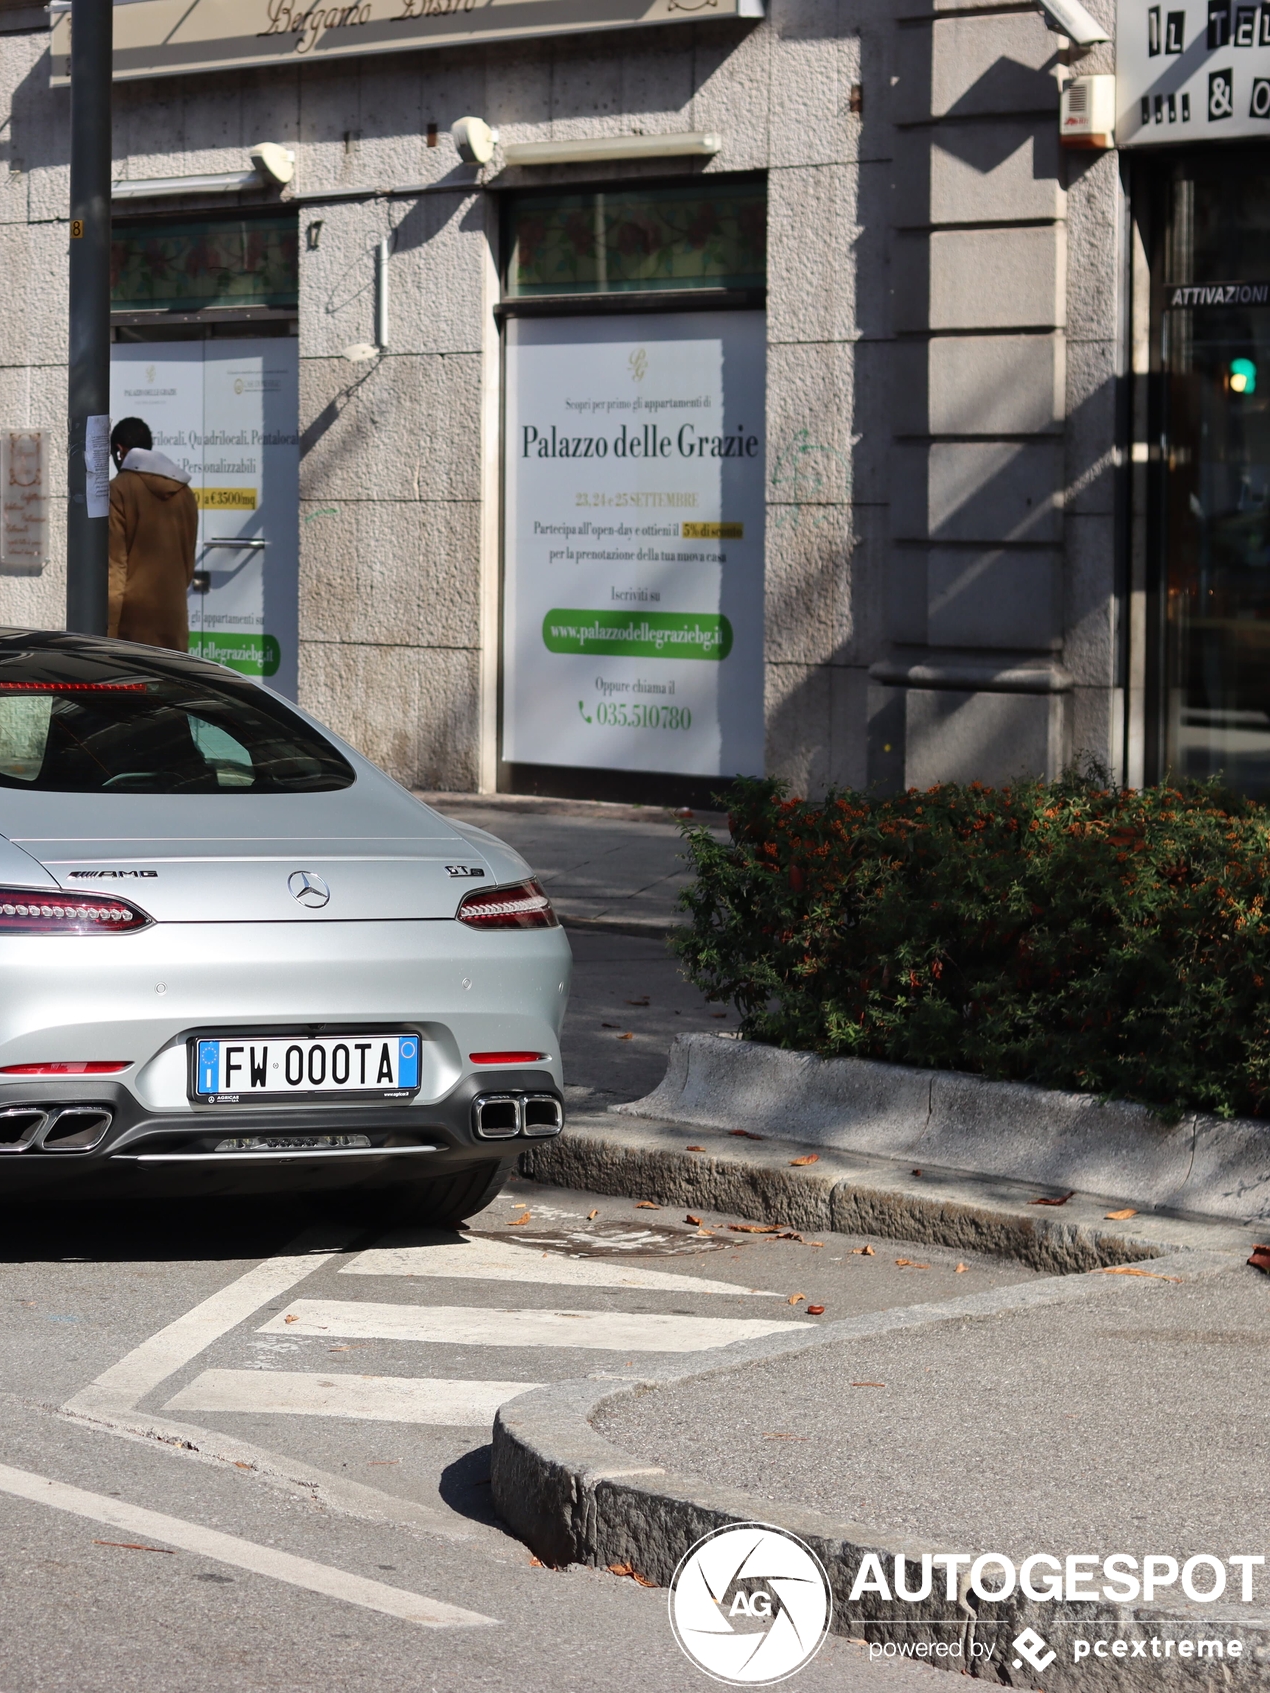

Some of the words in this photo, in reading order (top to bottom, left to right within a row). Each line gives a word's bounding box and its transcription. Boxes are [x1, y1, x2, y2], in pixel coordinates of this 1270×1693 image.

[256, 0, 372, 53] Bergamo
[1208, 5, 1270, 48] TEL
[1249, 79, 1270, 117] O
[1171, 286, 1269, 305] ATTIVAZIONI
[565, 398, 590, 413] Scopri
[592, 401, 606, 413] per
[607, 399, 631, 413] primo
[633, 398, 643, 413] gli
[644, 397, 702, 413] appartamenti
[703, 396, 711, 408] di
[152, 430, 187, 447] rilocali,
[251, 429, 299, 446] Pentalocal
[522, 425, 608, 458] Palazzo
[614, 424, 671, 458] delle
[677, 423, 759, 458] Grazie
[593, 493, 606, 507] 24
[608, 496, 614, 507] e
[615, 492, 628, 507] 25
[630, 492, 699, 508] SETTEMBRE
[534, 521, 577, 539] Partecipa
[635, 526, 641, 536] e
[642, 523, 671, 537] ottieni
[673, 522, 679, 536] il
[683, 524, 700, 537] 5%
[700, 524, 710, 537] di
[549, 549, 565, 563] per
[566, 547, 575, 560] la
[576, 548, 635, 563] prenotazione
[636, 548, 660, 562] della
[661, 551, 676, 562] tua
[677, 552, 705, 563] nuova
[706, 553, 727, 563] casa
[611, 586, 649, 602] Iscriviti
[650, 592, 661, 602] su
[550, 621, 723, 652] www.palazzodellegraziebg.it
[188, 641, 274, 668] odellegraziebg.it
[595, 676, 631, 696] Oppure
[632, 679, 667, 694] chiama
[668, 680, 675, 695] il
[597, 702, 692, 731] 035.510780
[225, 1046, 268, 1088] FW
[285, 1042, 394, 1086] 000TA
